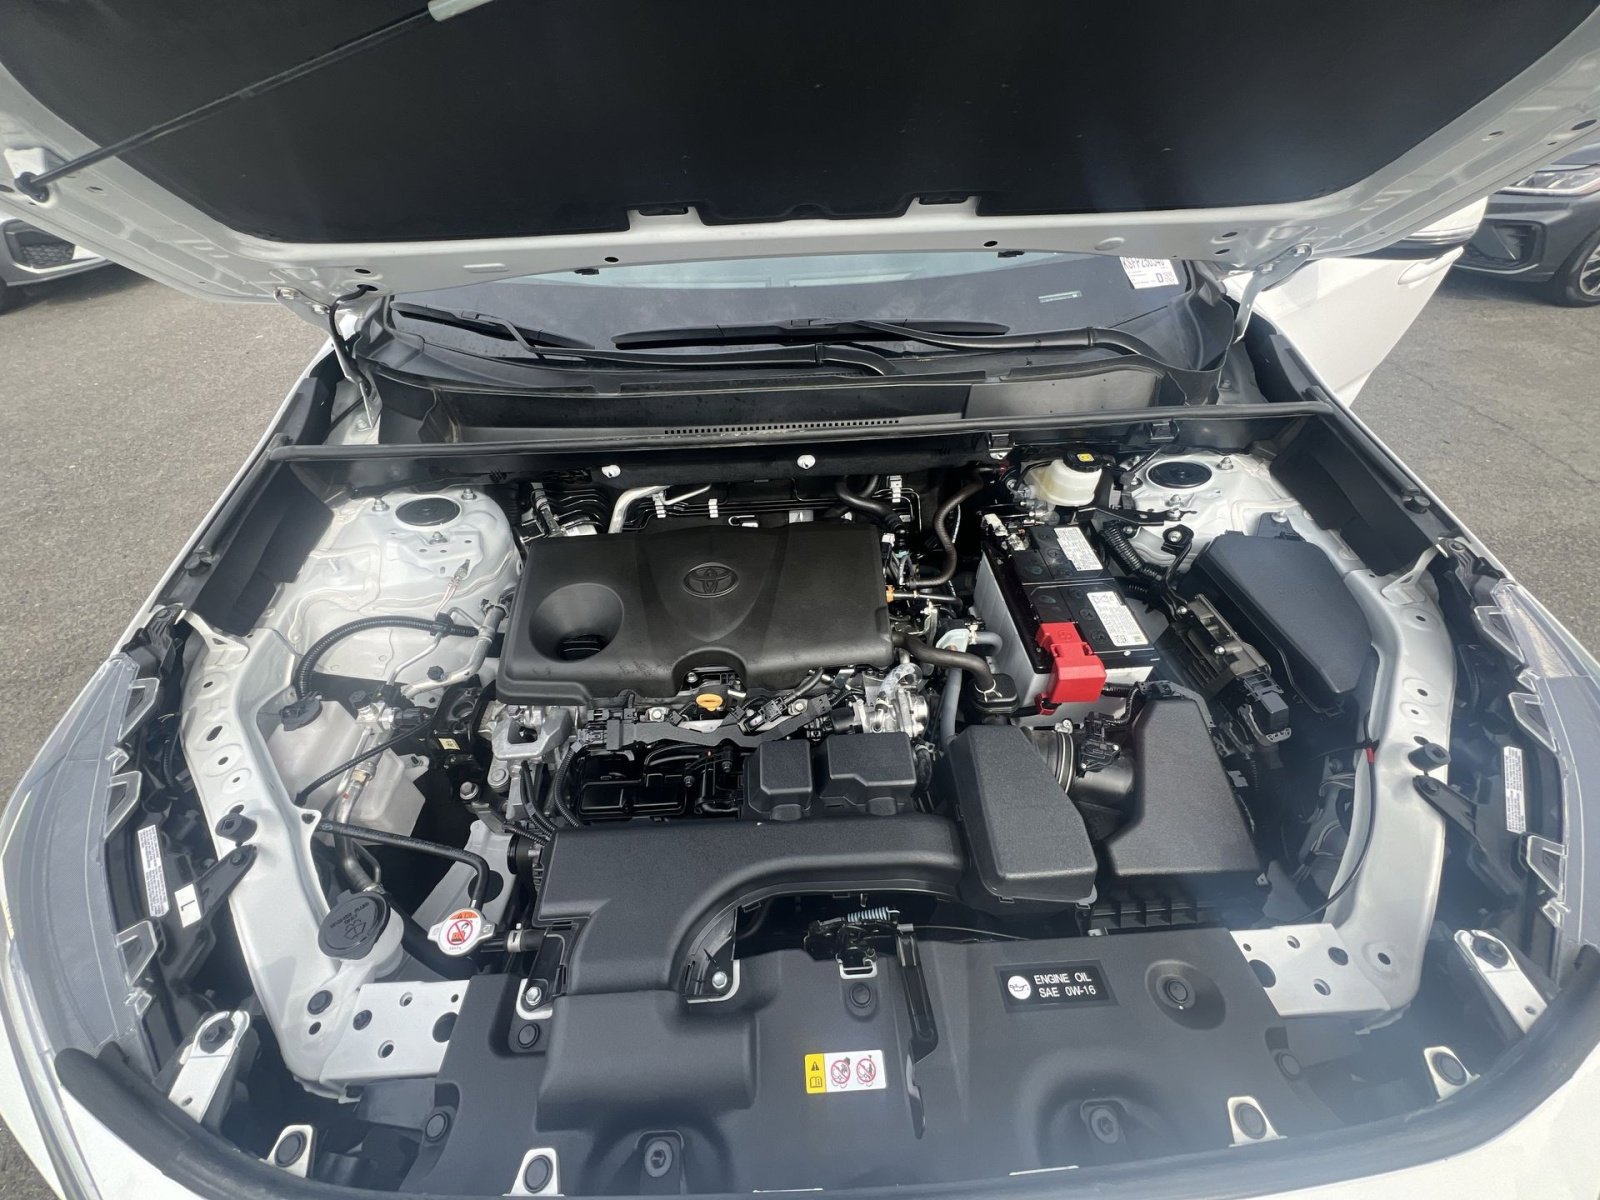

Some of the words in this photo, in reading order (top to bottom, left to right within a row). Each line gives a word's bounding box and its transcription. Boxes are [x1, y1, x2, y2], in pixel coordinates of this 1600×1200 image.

[180, 899, 196, 912] L
[1033, 973, 1070, 985] ENGINE
[1074, 972, 1092, 983] OIL
[1038, 987, 1060, 998] SAE
[1064, 985, 1097, 997] 0W-16
